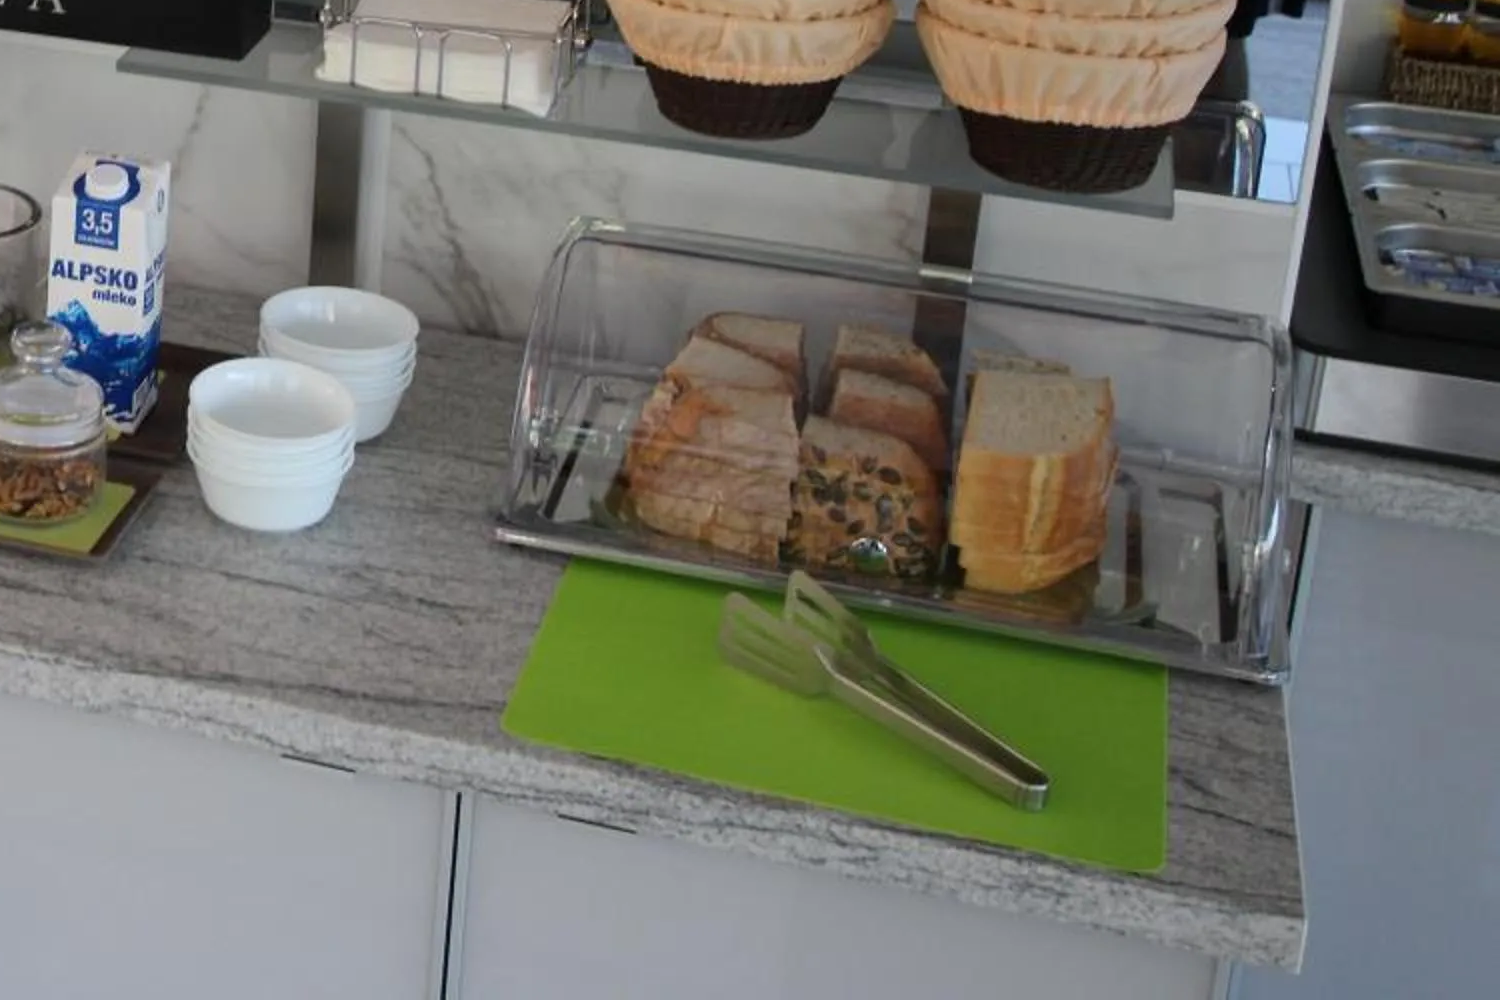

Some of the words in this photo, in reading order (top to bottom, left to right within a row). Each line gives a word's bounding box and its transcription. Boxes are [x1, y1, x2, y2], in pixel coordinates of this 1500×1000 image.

[82, 208, 113, 235] 3,5
[52, 259, 138, 290] ALPSKO
[92, 290, 137, 306] mleko
